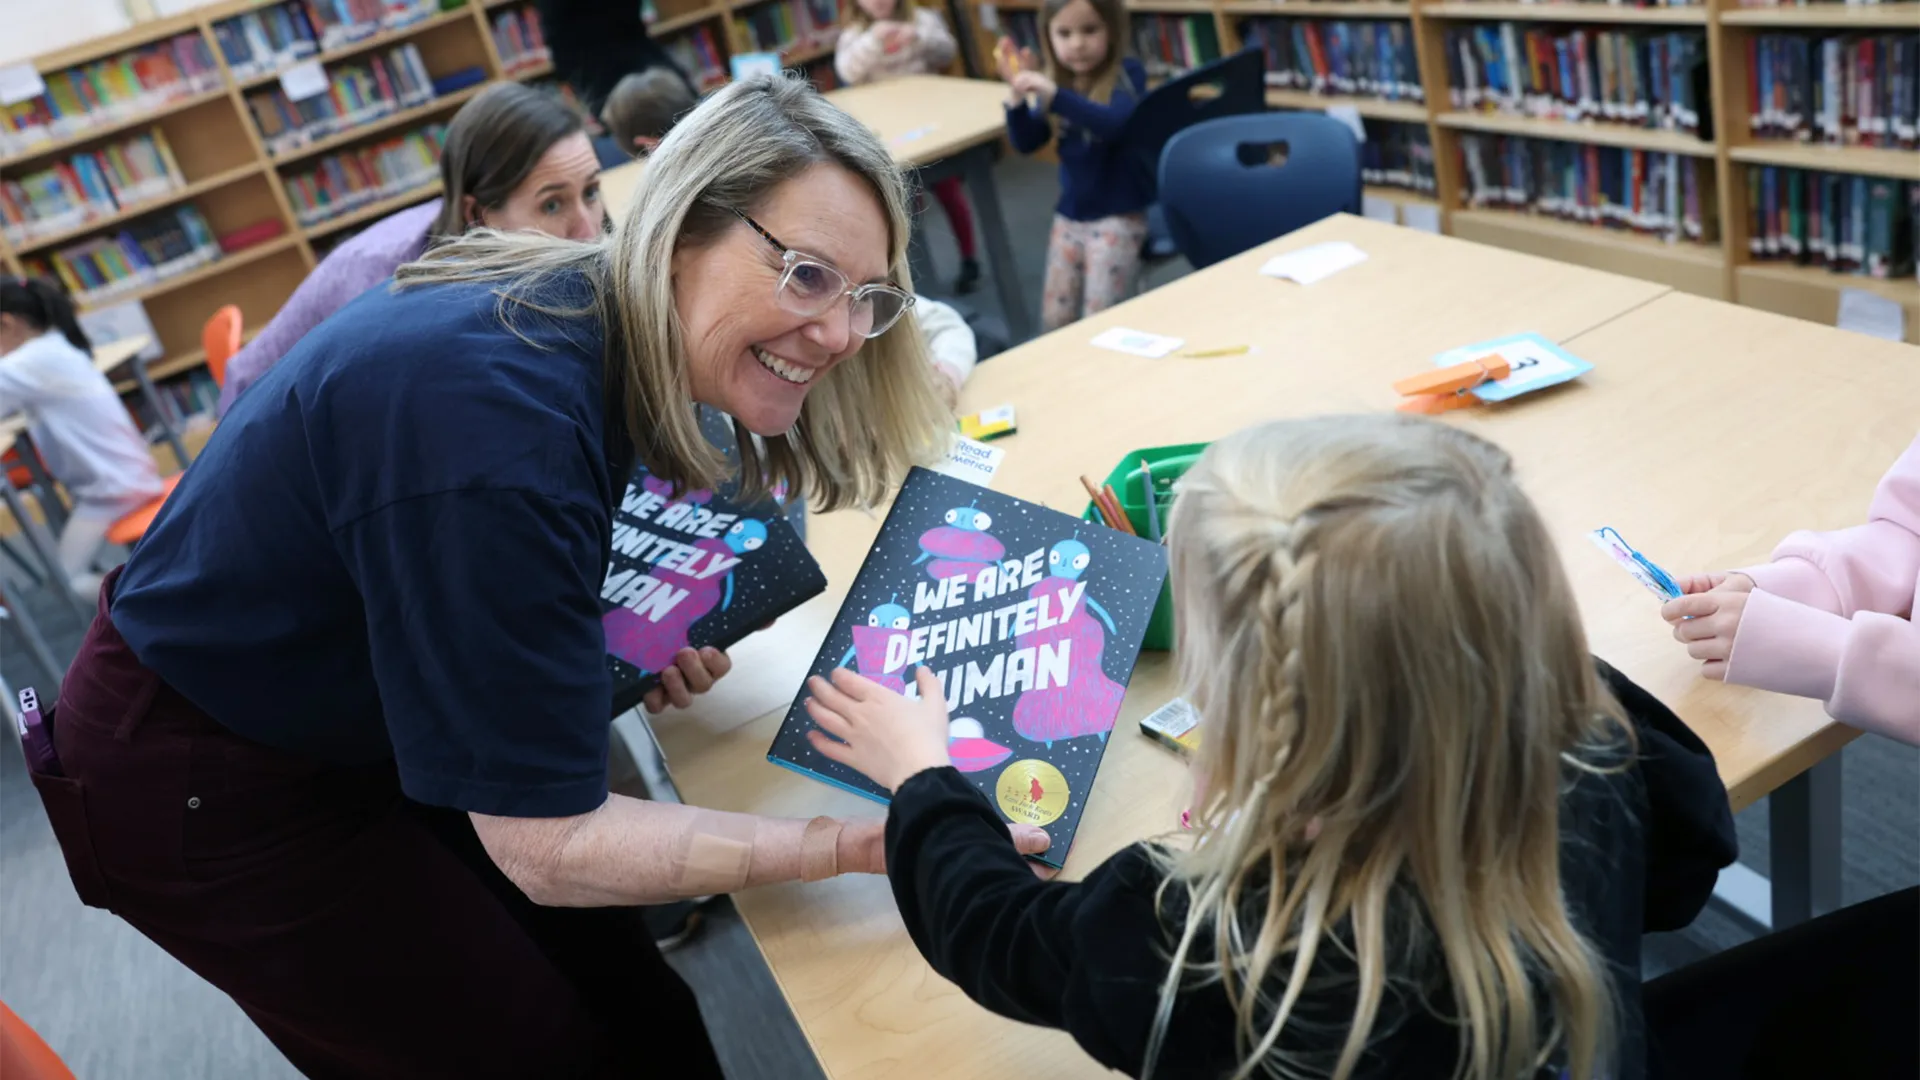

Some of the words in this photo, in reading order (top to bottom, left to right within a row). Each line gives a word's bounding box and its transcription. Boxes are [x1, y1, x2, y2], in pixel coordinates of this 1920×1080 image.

[620, 483, 667, 519] WE
[654, 503, 738, 538] ARE
[600, 562, 690, 623] MAN
[913, 574, 968, 614] WE
[974, 547, 1045, 602] ARE
[883, 581, 1088, 674] DEFINITELY
